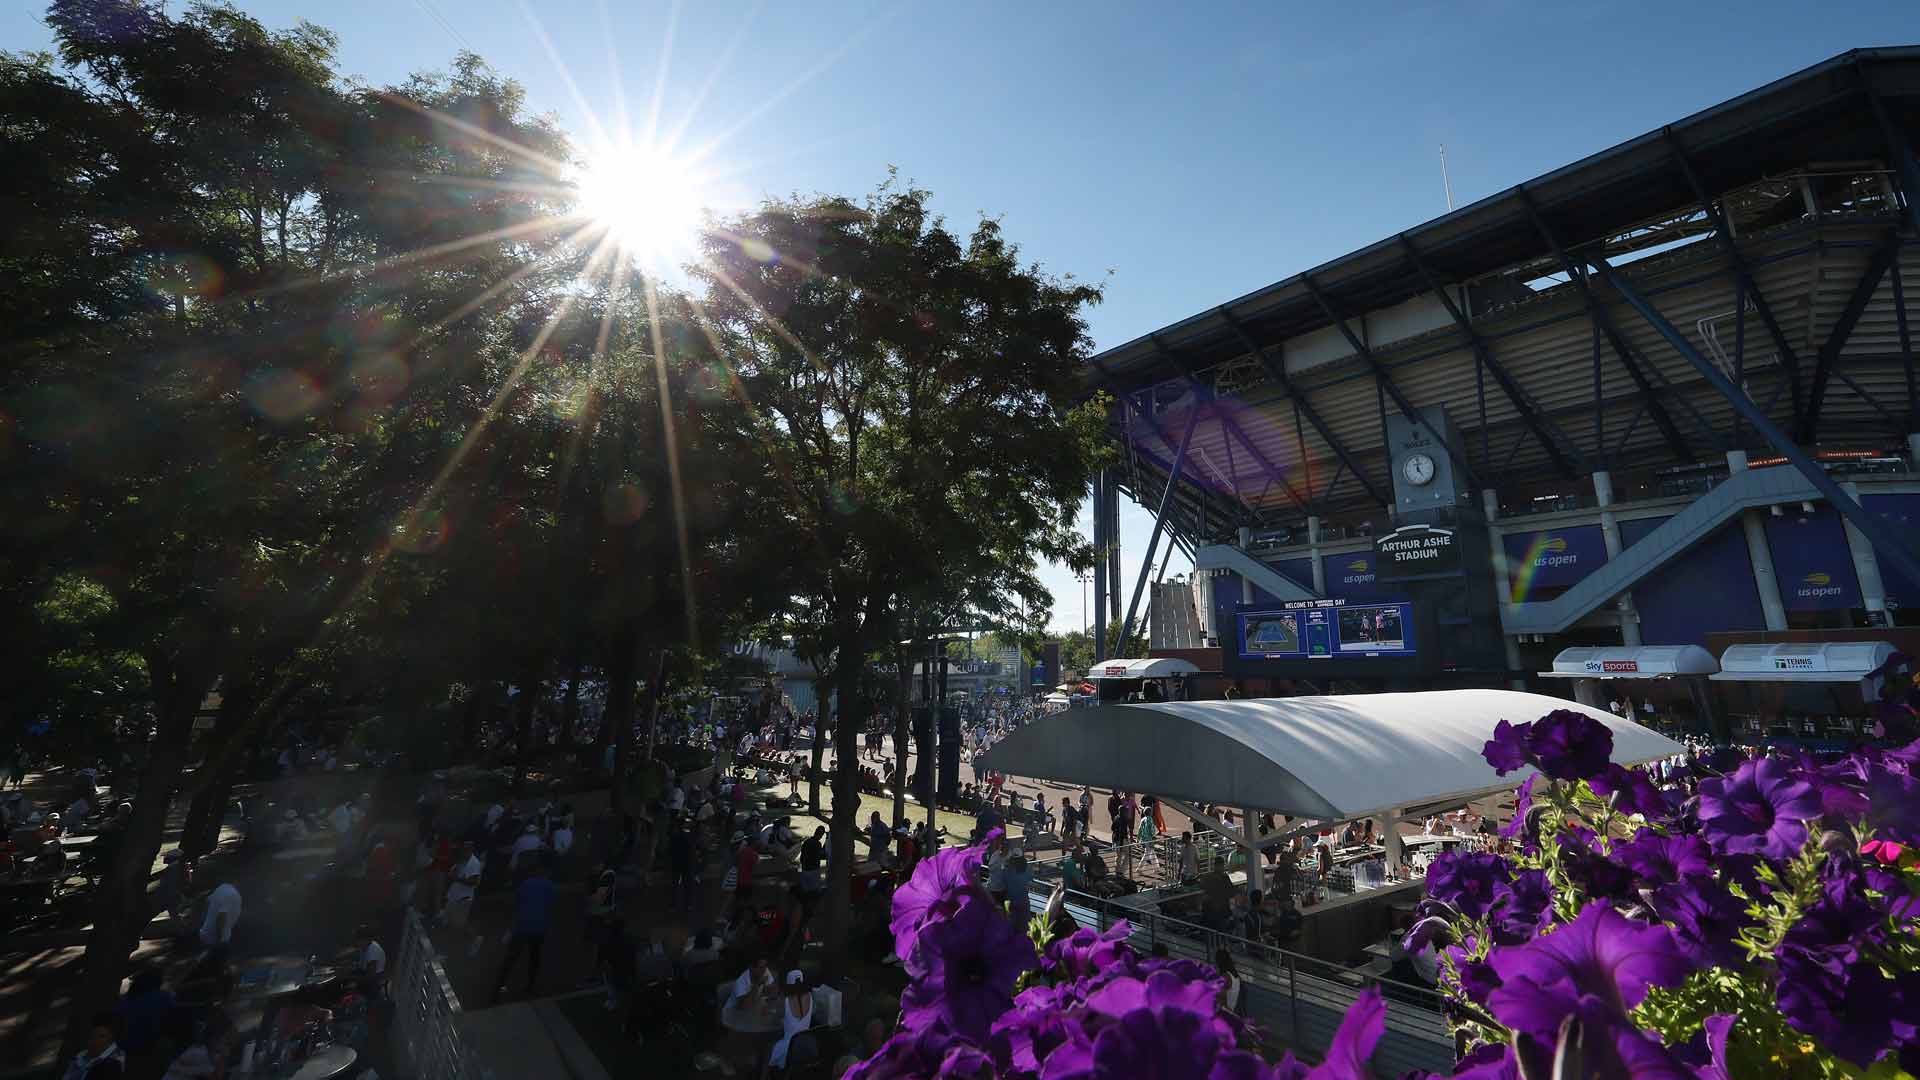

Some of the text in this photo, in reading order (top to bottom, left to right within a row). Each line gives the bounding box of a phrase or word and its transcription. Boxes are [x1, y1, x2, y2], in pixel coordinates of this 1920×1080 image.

[1381, 535, 1452, 552] ARTHUR ASHE
[1394, 548, 1438, 561] STADIUM
[1547, 554, 1577, 568] open
[1354, 573, 1375, 585] open
[1811, 585, 1841, 598] open
[1285, 601, 1307, 609] WELCOME
[1585, 661, 1636, 673] sky sports
[1786, 657, 1813, 665] TENNIS
[1105, 666, 1127, 675] ESPN
